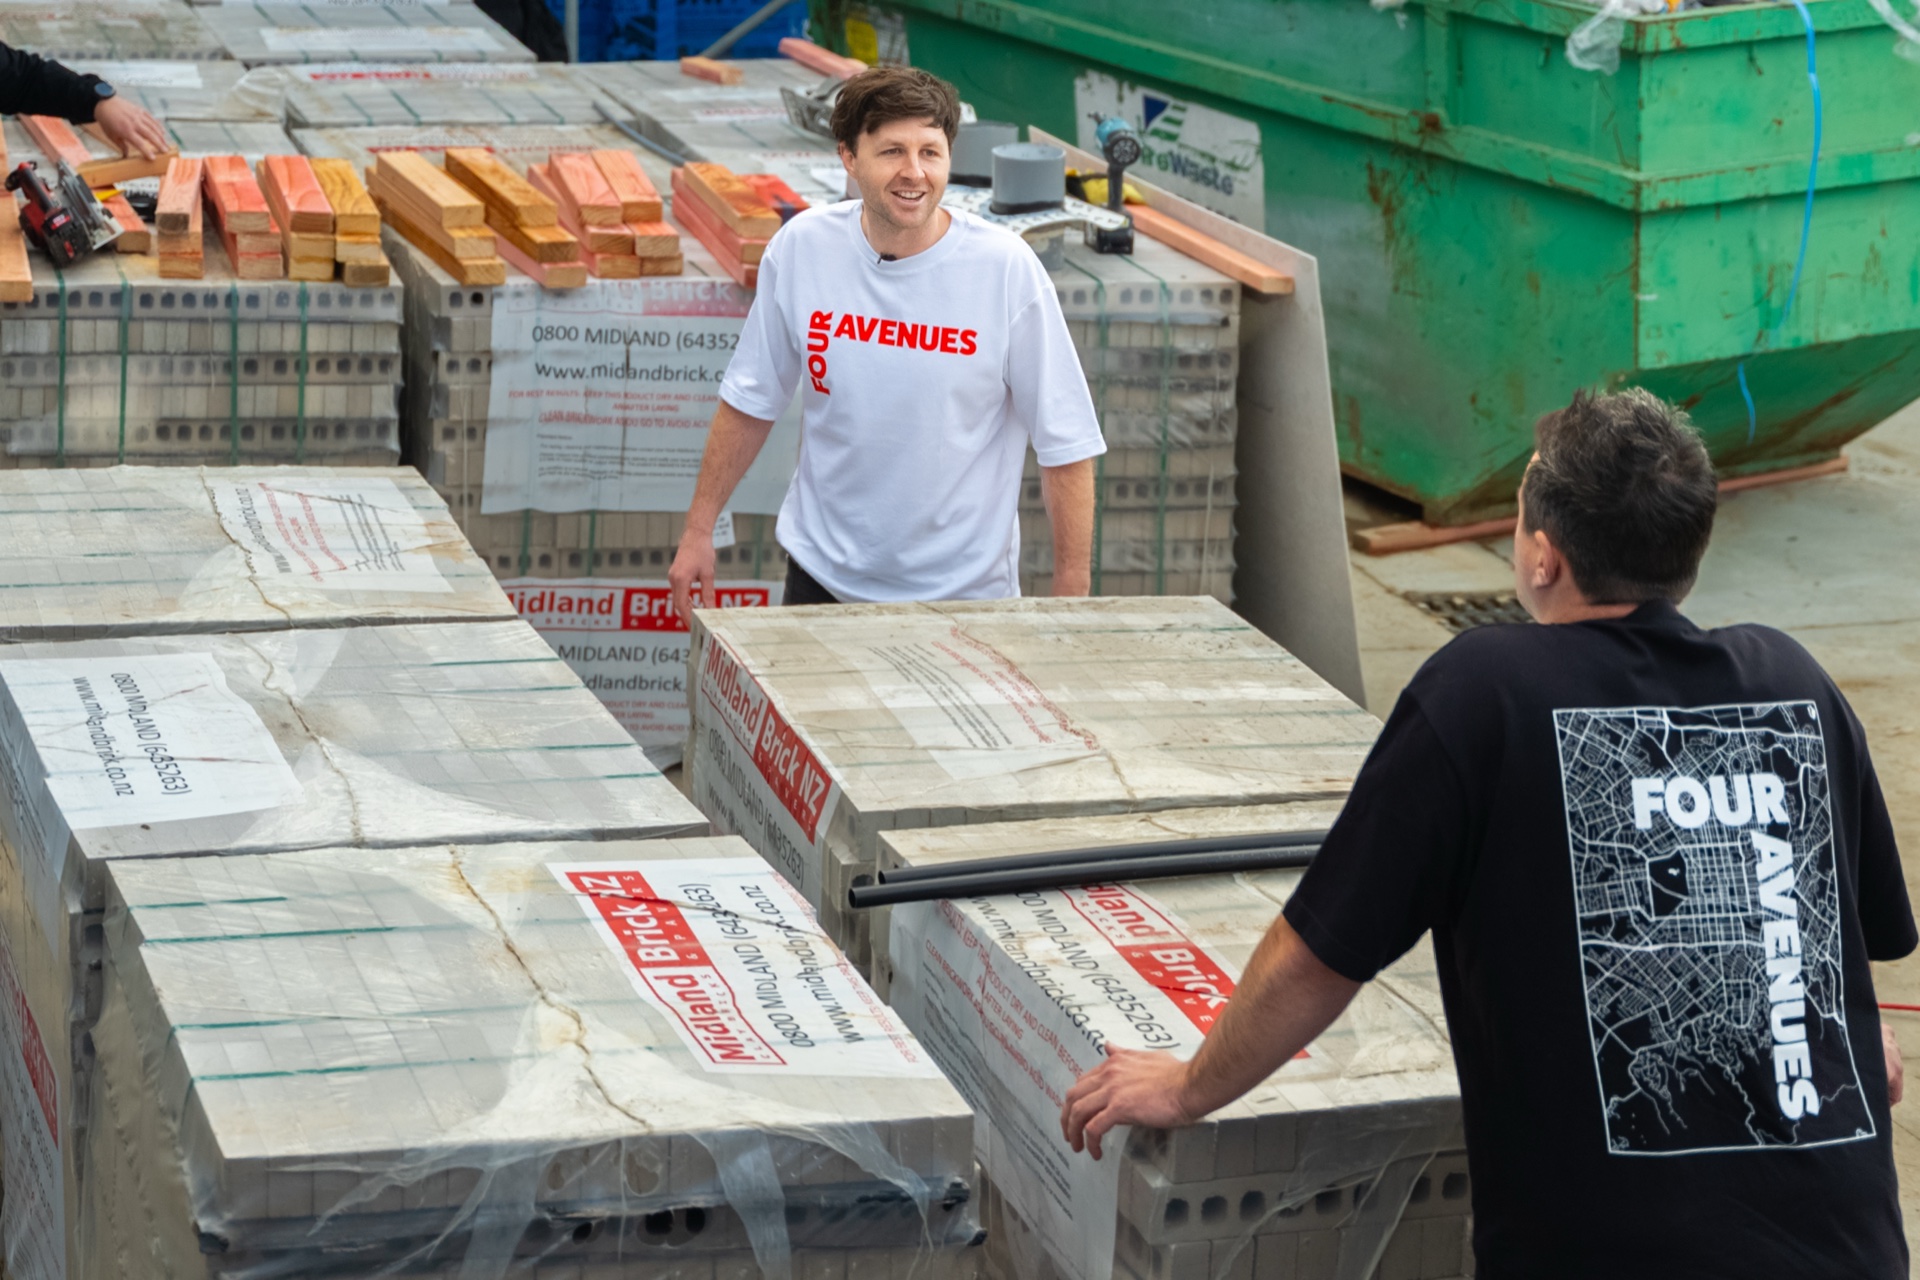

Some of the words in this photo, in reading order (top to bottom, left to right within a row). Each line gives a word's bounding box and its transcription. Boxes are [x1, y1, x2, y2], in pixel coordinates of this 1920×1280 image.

[532, 325, 579, 343] 0800
[585, 327, 671, 347] MIDLAND
[676, 331, 740, 352] (64352
[807, 310, 833, 395] FOUR
[833, 313, 978, 356] AVENUES
[111, 673, 140, 694] 0800
[558, 645, 646, 662] MIDLAND
[707, 634, 763, 735] Midland
[761, 713, 800, 787] Brick
[799, 761, 825, 816] NZ
[1631, 772, 1790, 830] FOUR
[610, 903, 680, 963] Brick
[1081, 883, 1172, 937] dland
[1150, 947, 1230, 1010] Brick
[733, 943, 787, 1009] MIDLAND
[1016, 891, 1047, 906] 00
[1032, 908, 1099, 970] MIDLAND
[1081, 971, 1181, 1050] (6435263)
[1750, 829, 1819, 1122] AVENUES
[653, 974, 756, 1061] Midland
[767, 1012, 815, 1049] 0800
